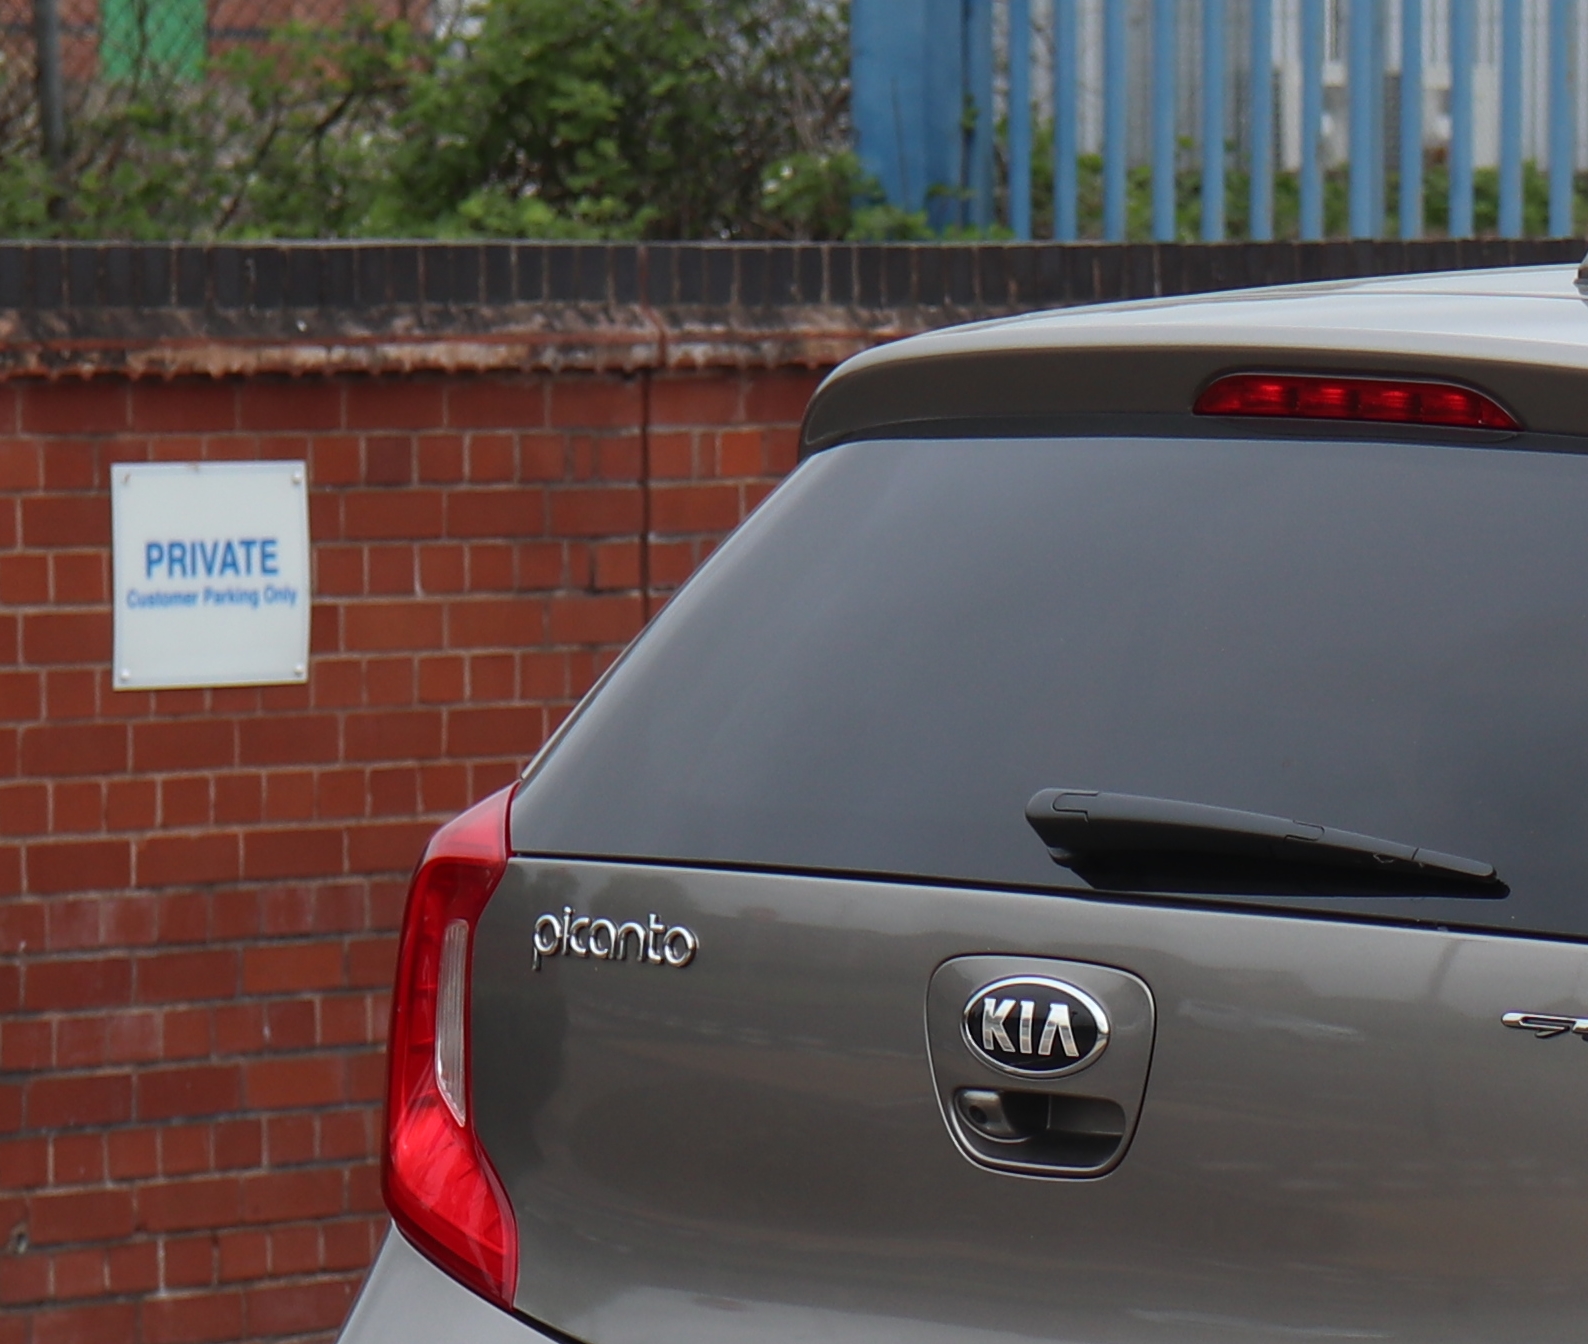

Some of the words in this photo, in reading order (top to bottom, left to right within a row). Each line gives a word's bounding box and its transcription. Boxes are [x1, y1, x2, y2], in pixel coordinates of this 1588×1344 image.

[145, 538, 279, 578] PRIVATE
[127, 589, 197, 609] Customer
[203, 586, 259, 609] Parking
[264, 584, 297, 607] Only
[532, 905, 700, 972] picanto
[981, 997, 1080, 1058] KIA
